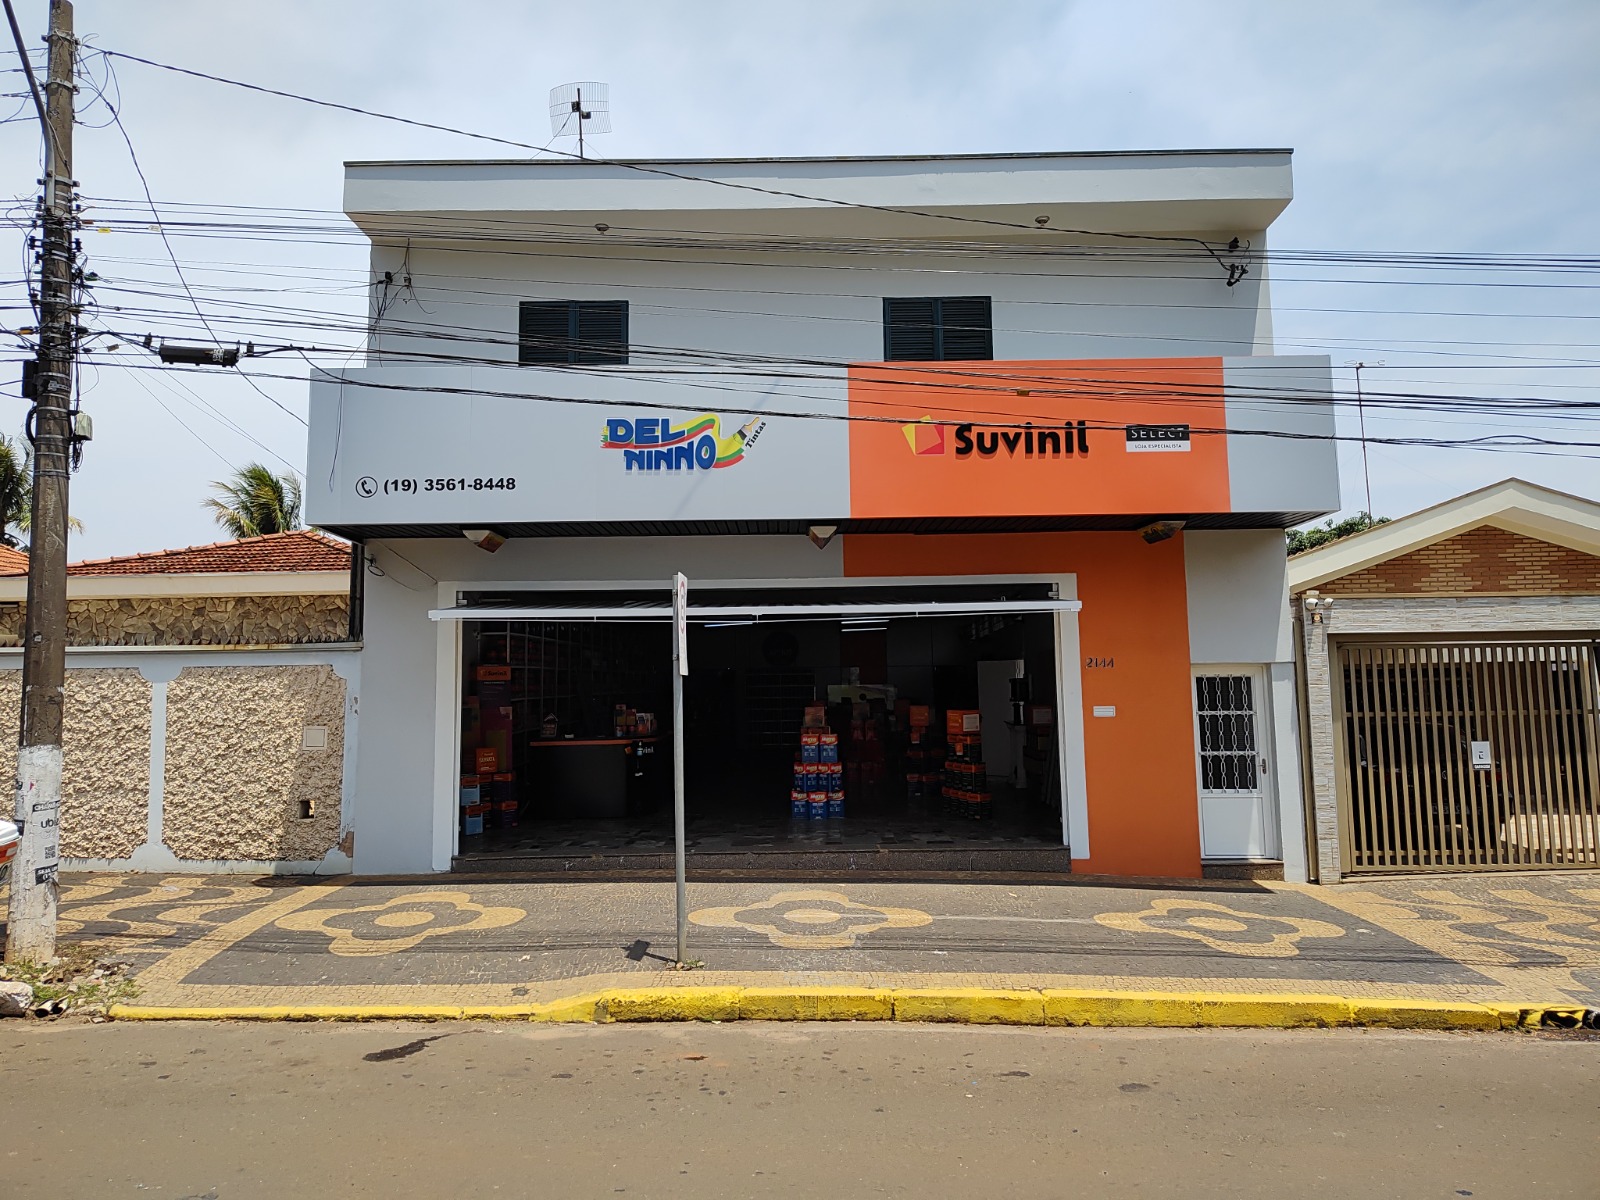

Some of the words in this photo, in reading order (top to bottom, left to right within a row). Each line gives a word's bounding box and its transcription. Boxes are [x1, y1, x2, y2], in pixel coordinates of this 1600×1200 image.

[606, 418, 686, 445] DEL
[745, 421, 767, 449] Tintas
[955, 420, 1089, 455] Suvinil
[1131, 428, 1184, 439] SELECT
[624, 434, 717, 471] NINNO
[384, 478, 418, 495] (19)
[424, 477, 516, 491] 3561-8448
[1087, 657, 1115, 668] 2144
